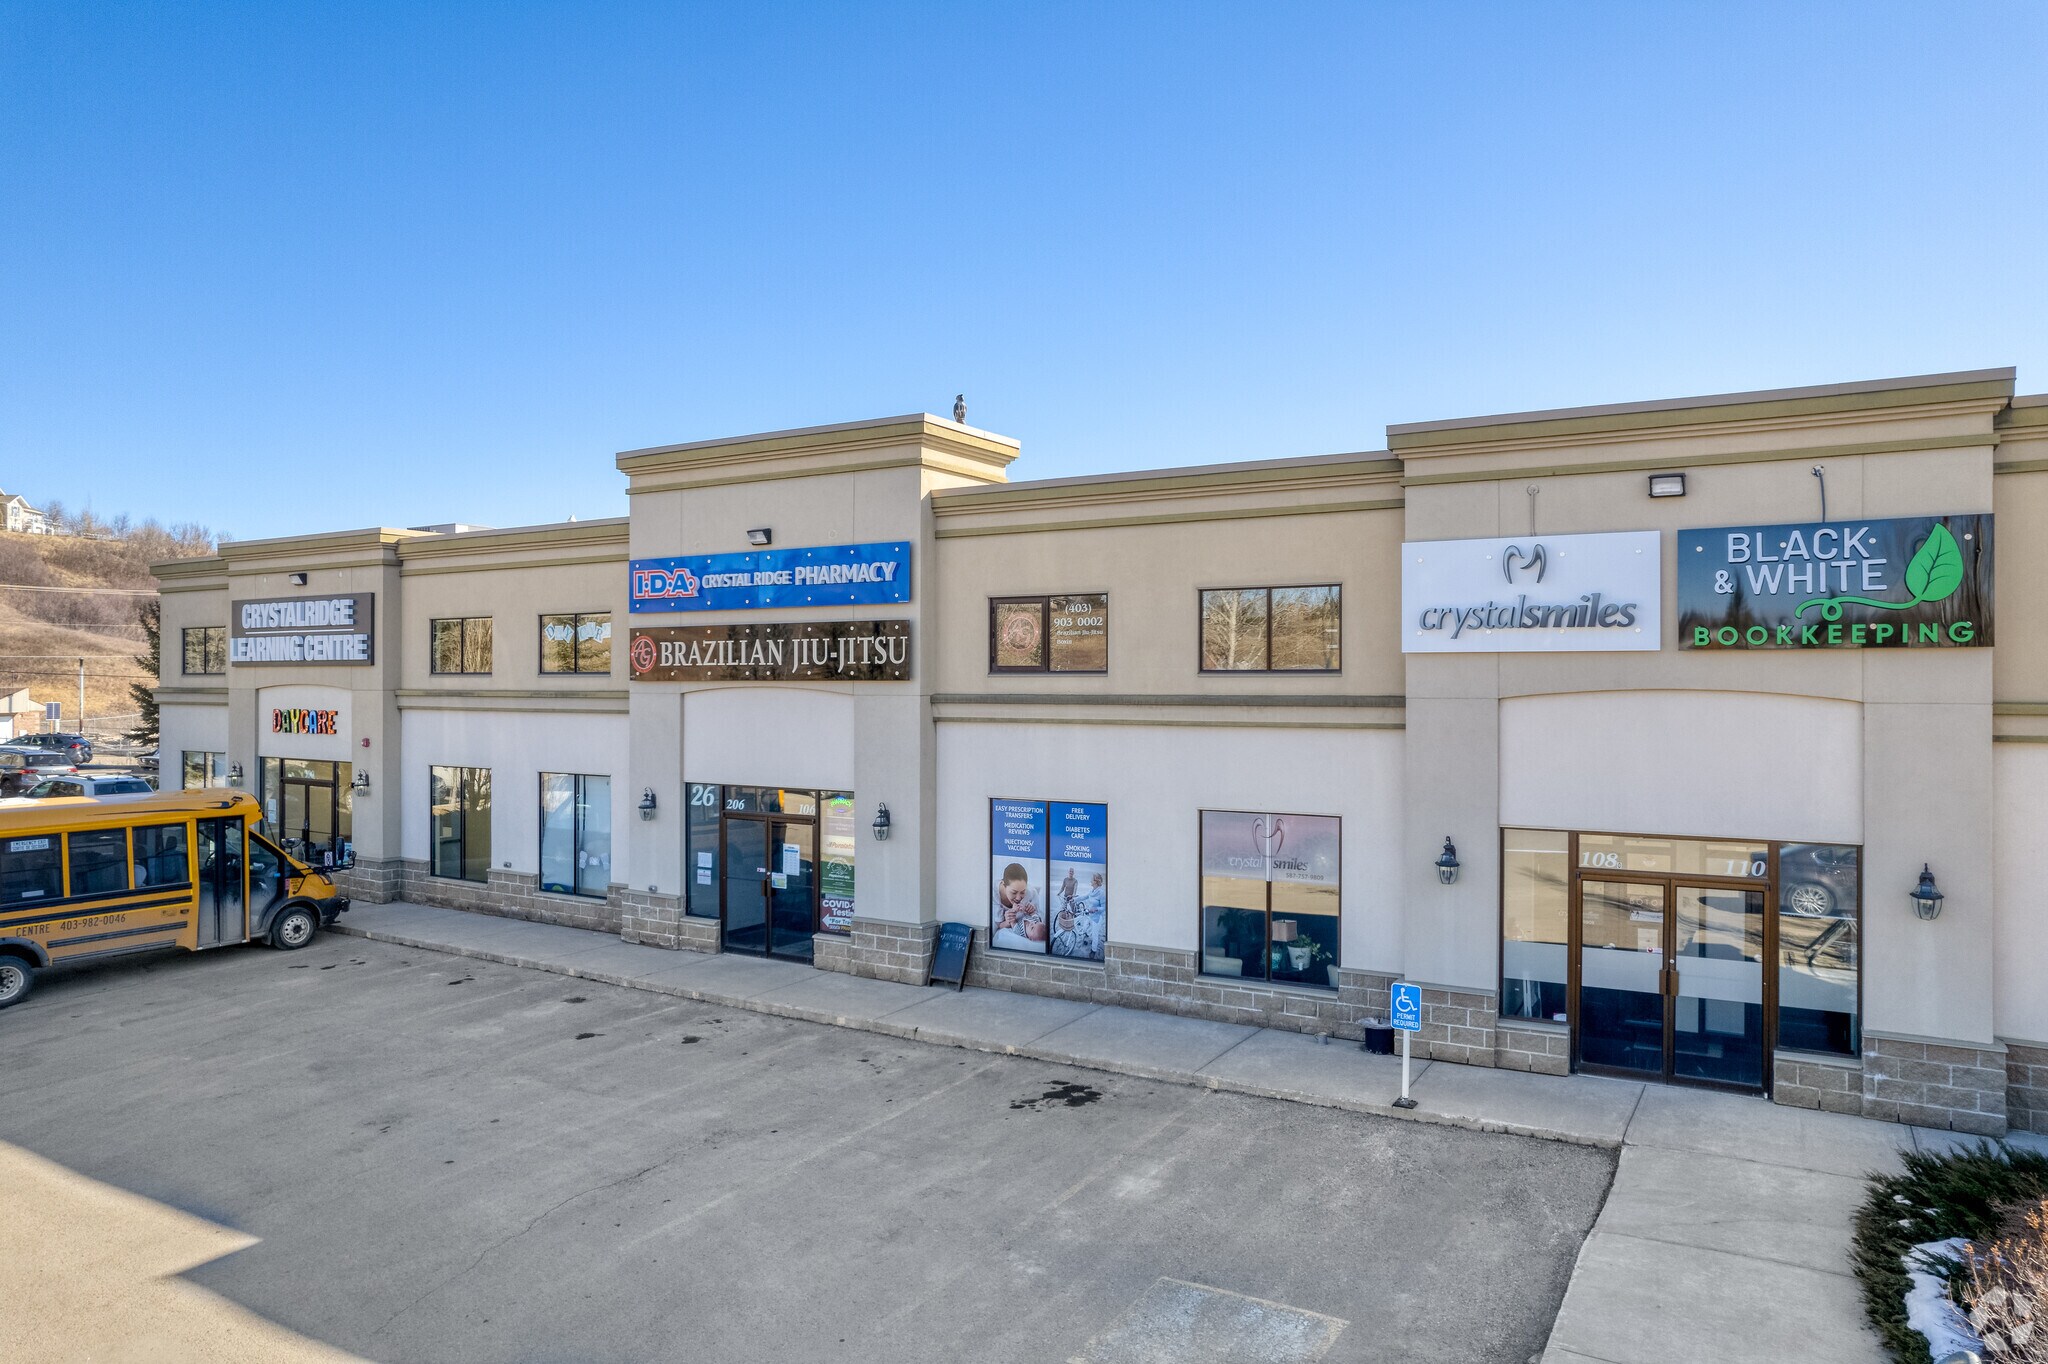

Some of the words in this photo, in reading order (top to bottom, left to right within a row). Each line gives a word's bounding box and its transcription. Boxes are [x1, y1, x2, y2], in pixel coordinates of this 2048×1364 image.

[1727, 526, 1870, 563] BLACK
[702, 572, 753, 589] CRYSTAL
[754, 570, 792, 586] RIDGE
[794, 561, 897, 586] PHARMACY
[1714, 569, 1734, 594] &
[1746, 558, 1888, 595] WHITE
[241, 598, 355, 629] CRYSTALRIDGE
[1065, 603, 1092, 615] (403)
[1053, 617, 1073, 627] 903
[1077, 616, 1104, 627] 0002
[1418, 592, 1638, 640] crystalsmiles
[1693, 620, 1975, 647] BOOKKEEPING
[230, 635, 304, 662] LEARNING
[304, 633, 368, 661] CENTRE
[659, 638, 785, 667] BRAZILIAN
[791, 635, 908, 673] JIU-JITSU
[272, 708, 339, 735] DAYCARE
[691, 785, 715, 807] 26
[726, 798, 745, 810] 206
[798, 803, 816, 815] 106
[1008, 805, 1044, 814] PRESCRIPTION
[1005, 812, 1034, 820] TRANSFERS
[1065, 813, 1090, 821] DELIVERY
[1004, 822, 1034, 830] MEDICATION
[1065, 825, 1091, 834] DIABETES
[1070, 832, 1085, 840] CARE
[1004, 838, 1034, 847] INJECTIONS/
[1065, 844, 1090, 852] SMOKING
[1007, 845, 1031, 853] VACCINES
[1063, 851, 1092, 859] CESSATION
[1229, 855, 1263, 870] crystal
[1273, 857, 1309, 871] smiles
[1580, 851, 1618, 868] 108
[1724, 859, 1767, 877] 110
[16, 923, 50, 937] CENTRE
[60, 913, 126, 931] 403-982-0046
[1396, 1012, 1416, 1021] PERMIT
[1393, 1018, 1419, 1028] REQUIRED
